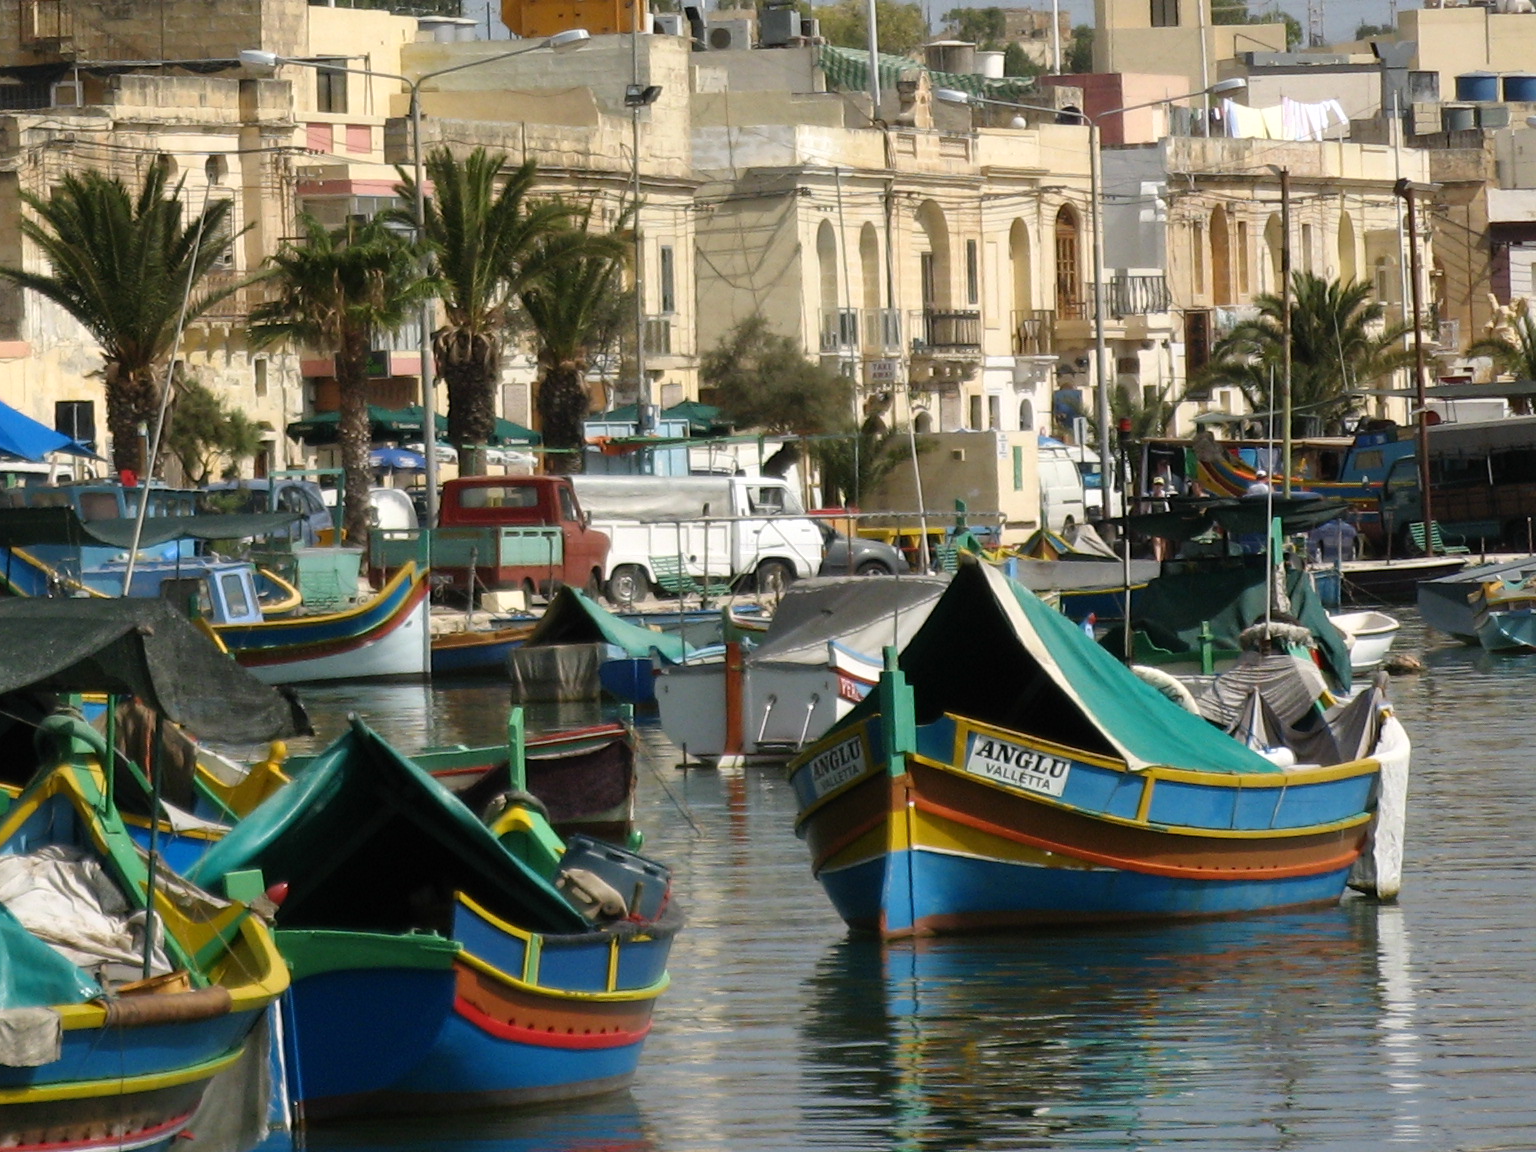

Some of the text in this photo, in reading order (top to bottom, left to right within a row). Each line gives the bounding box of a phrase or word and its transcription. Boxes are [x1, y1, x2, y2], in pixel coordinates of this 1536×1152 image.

[813, 740, 861, 781] ANGLU
[975, 740, 1067, 779] ANGLU
[985, 762, 1051, 791] VALLETTA
[820, 764, 860, 791] VALLETTA
